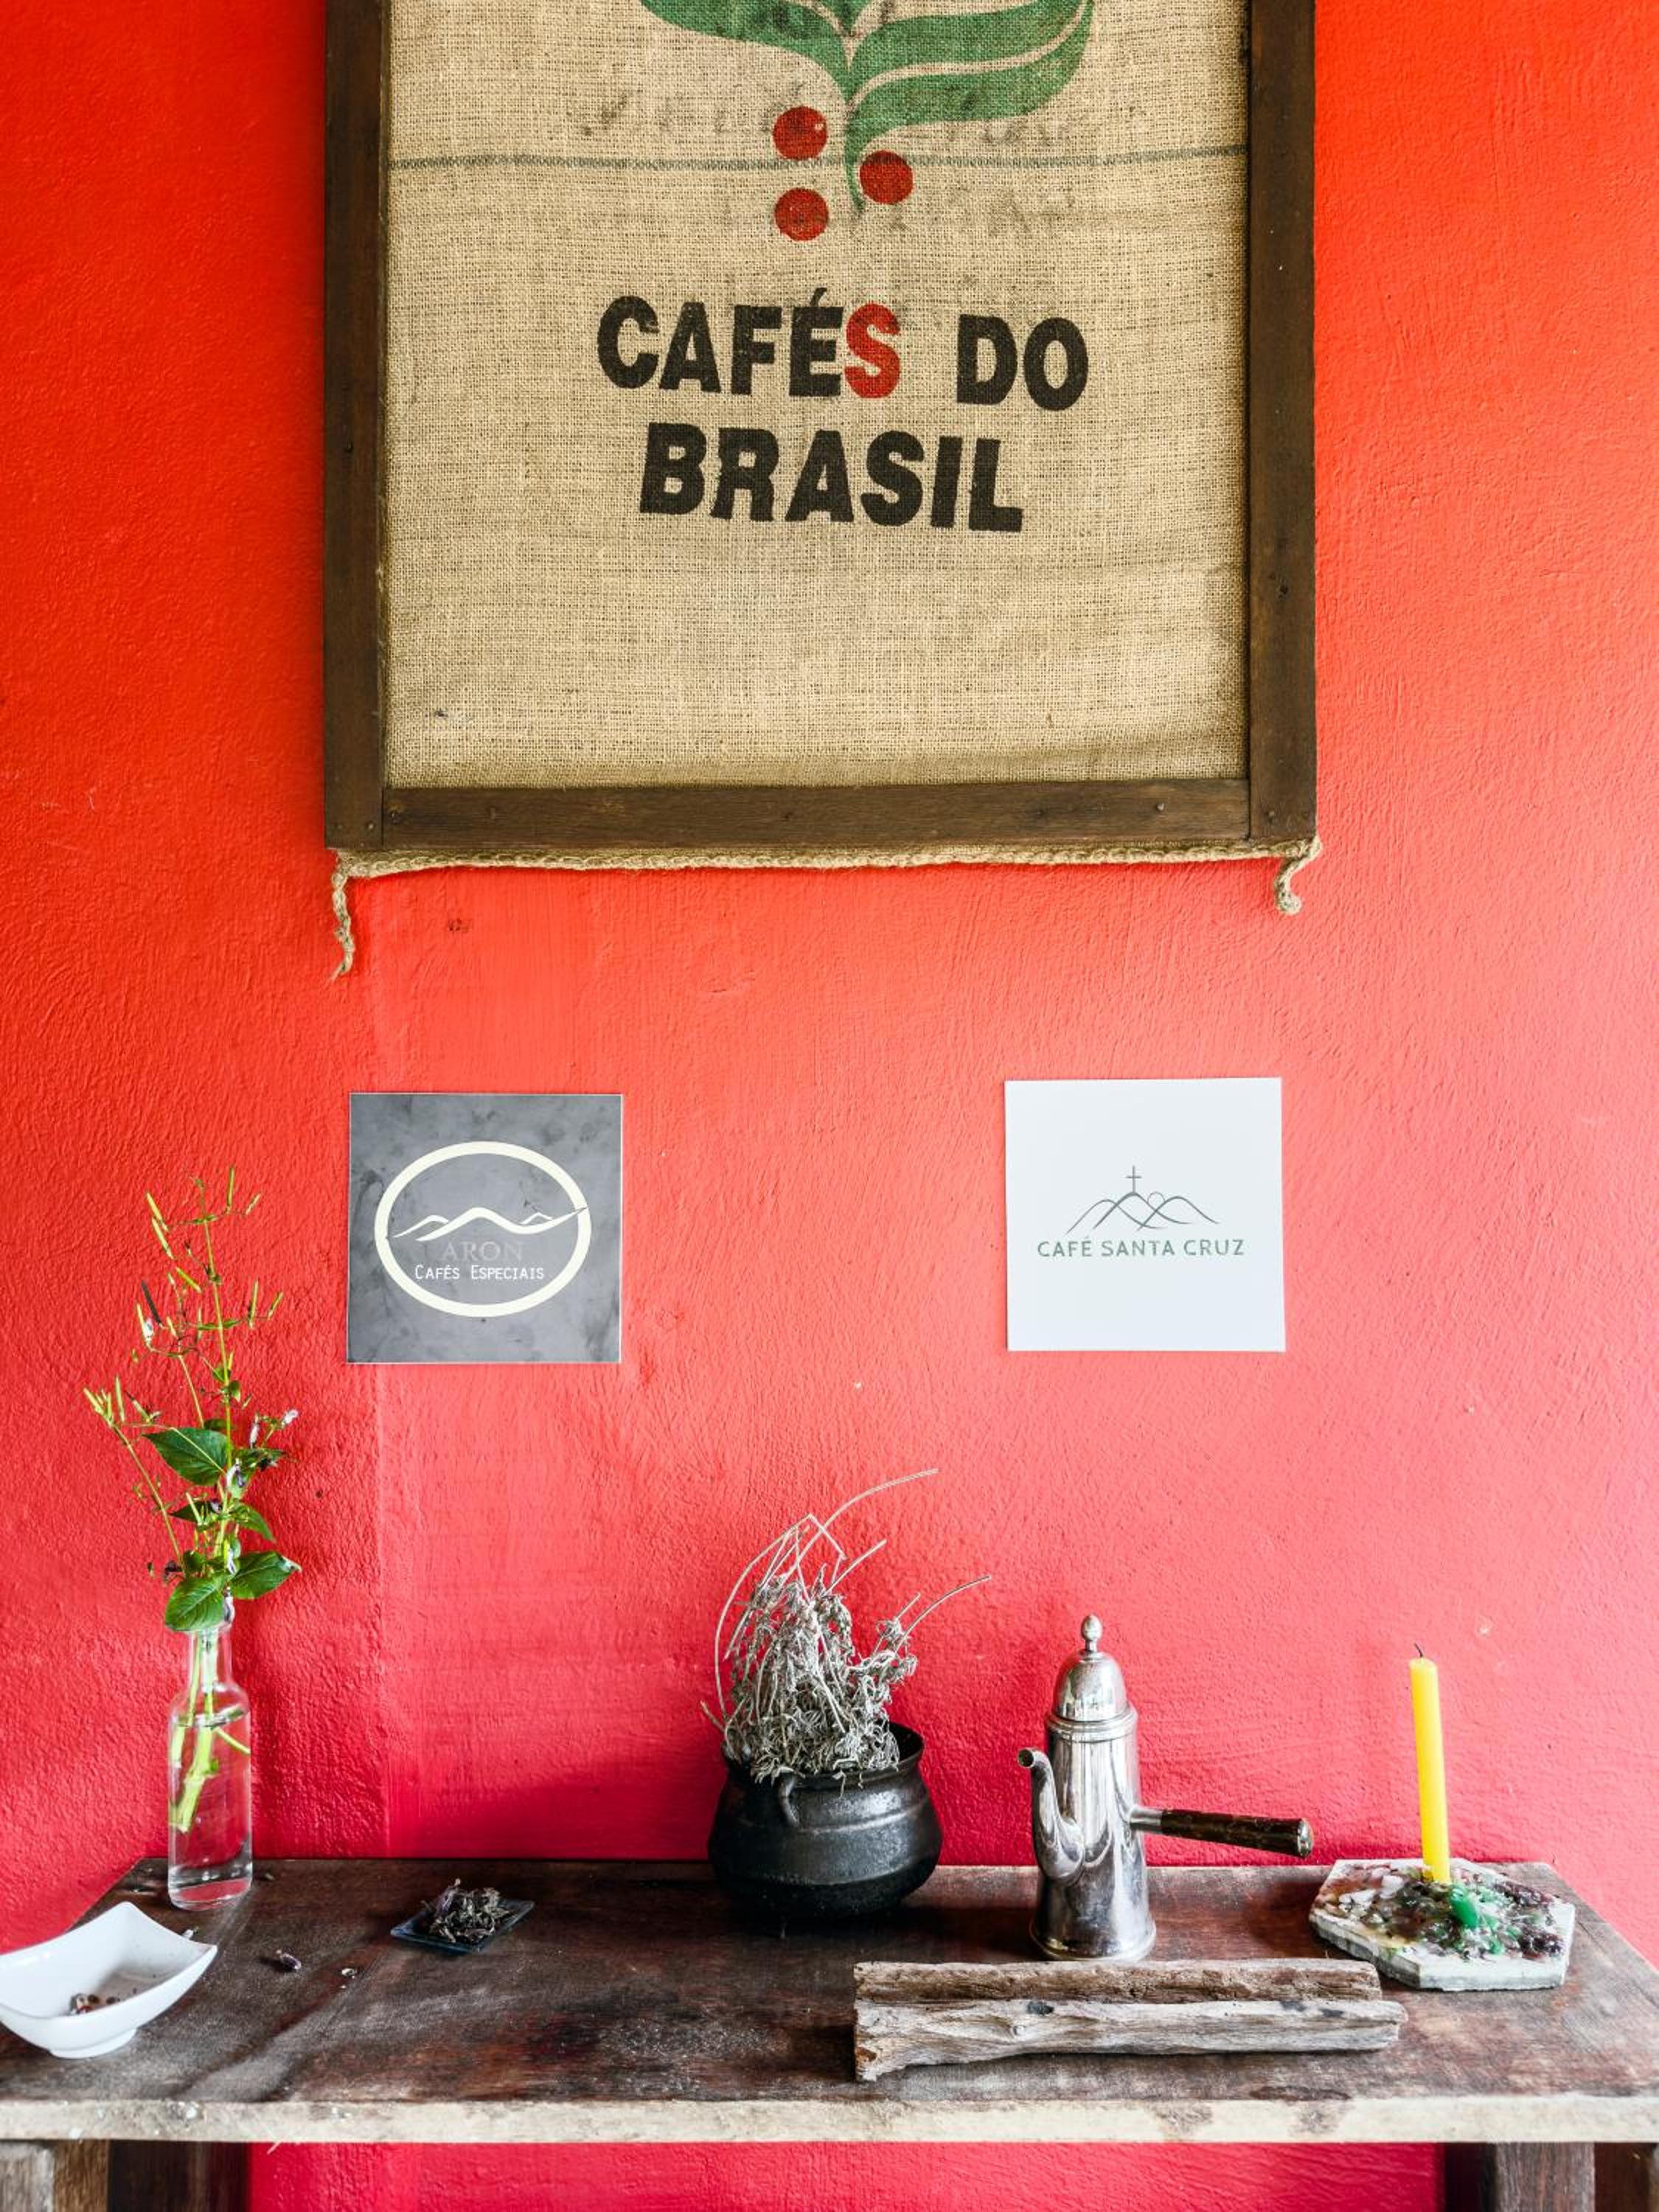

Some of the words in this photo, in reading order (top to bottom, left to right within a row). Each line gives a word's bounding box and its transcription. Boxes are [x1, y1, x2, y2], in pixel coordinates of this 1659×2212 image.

[597, 288, 901, 399] CAFÉS
[956, 314, 1089, 411] DO
[640, 422, 1023, 533] BRASIL
[470, 1264, 544, 1280] ESPECIAIS
[1037, 1236, 1093, 1257] CAFÉ
[1101, 1239, 1175, 1257] SANTA
[1183, 1239, 1245, 1256] CRUZ
